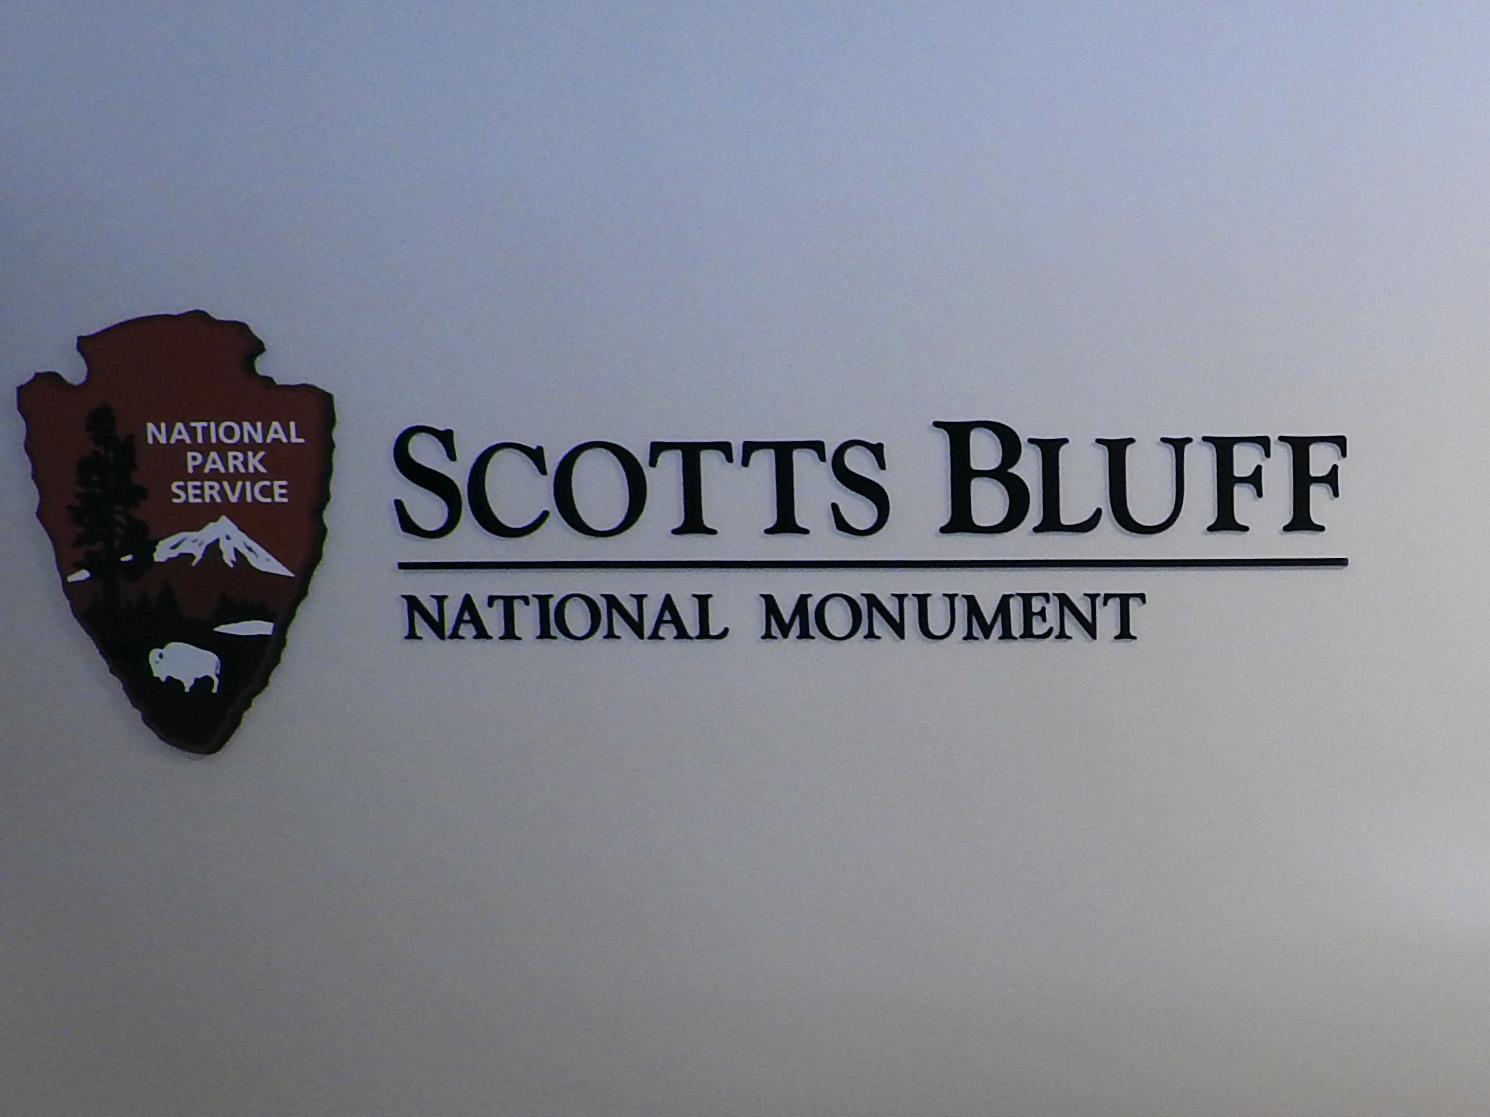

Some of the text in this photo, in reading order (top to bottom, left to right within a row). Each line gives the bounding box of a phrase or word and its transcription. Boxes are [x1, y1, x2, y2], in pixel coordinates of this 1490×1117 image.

[145, 420, 305, 444] NATIONAL
[185, 451, 268, 474] PARK
[392, 419, 1348, 539] SCOTTS BLUFF
[170, 480, 289, 503] SERVICE
[403, 592, 1146, 641] NATIONAL MONUMENT
